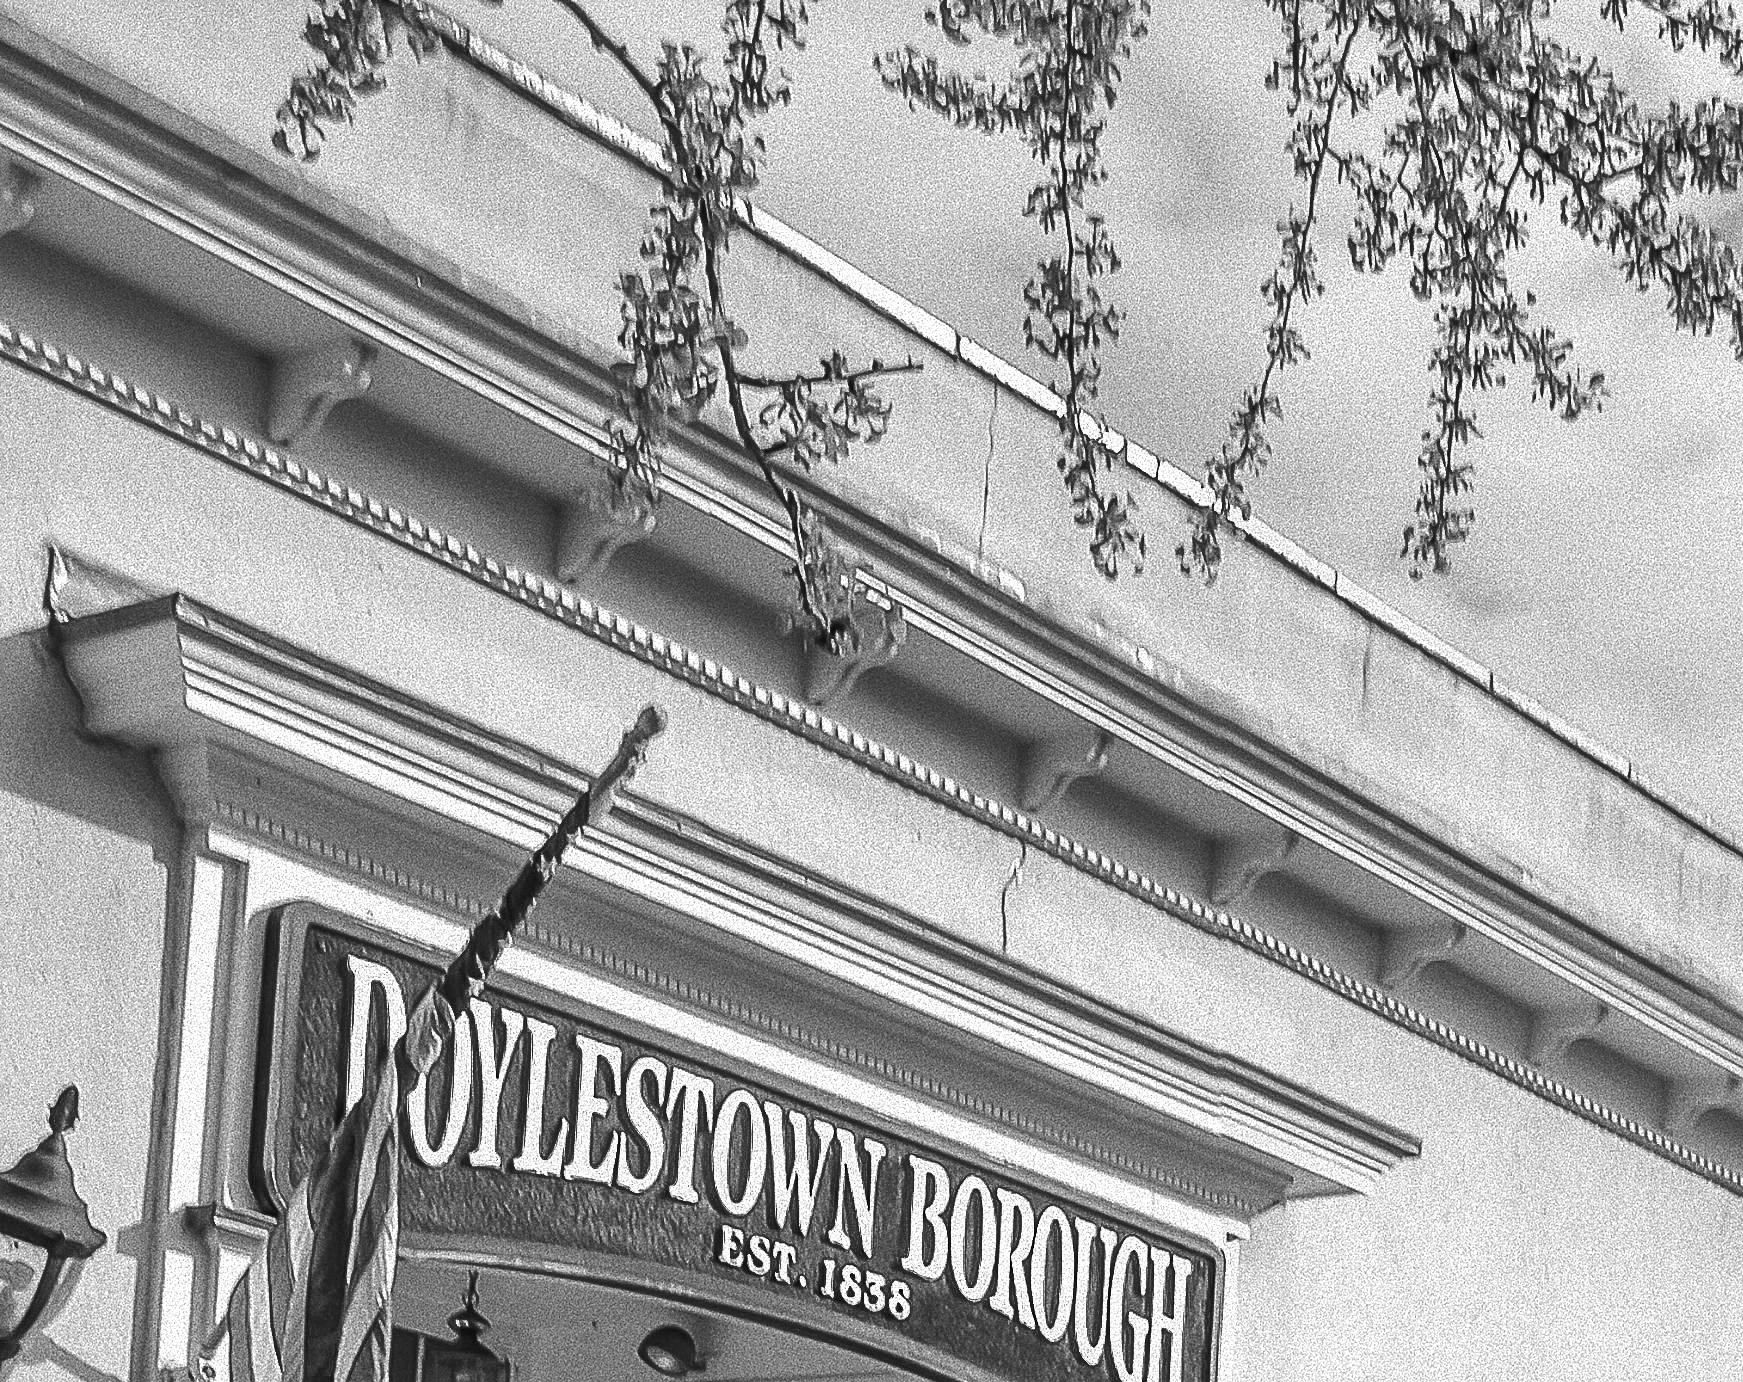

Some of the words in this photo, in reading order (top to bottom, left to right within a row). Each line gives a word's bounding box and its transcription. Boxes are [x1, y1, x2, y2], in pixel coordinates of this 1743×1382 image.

[346, 954, 887, 1259] DOYLESTOWN
[718, 1224, 807, 1288] EST.
[820, 1259, 911, 1321] 1838
